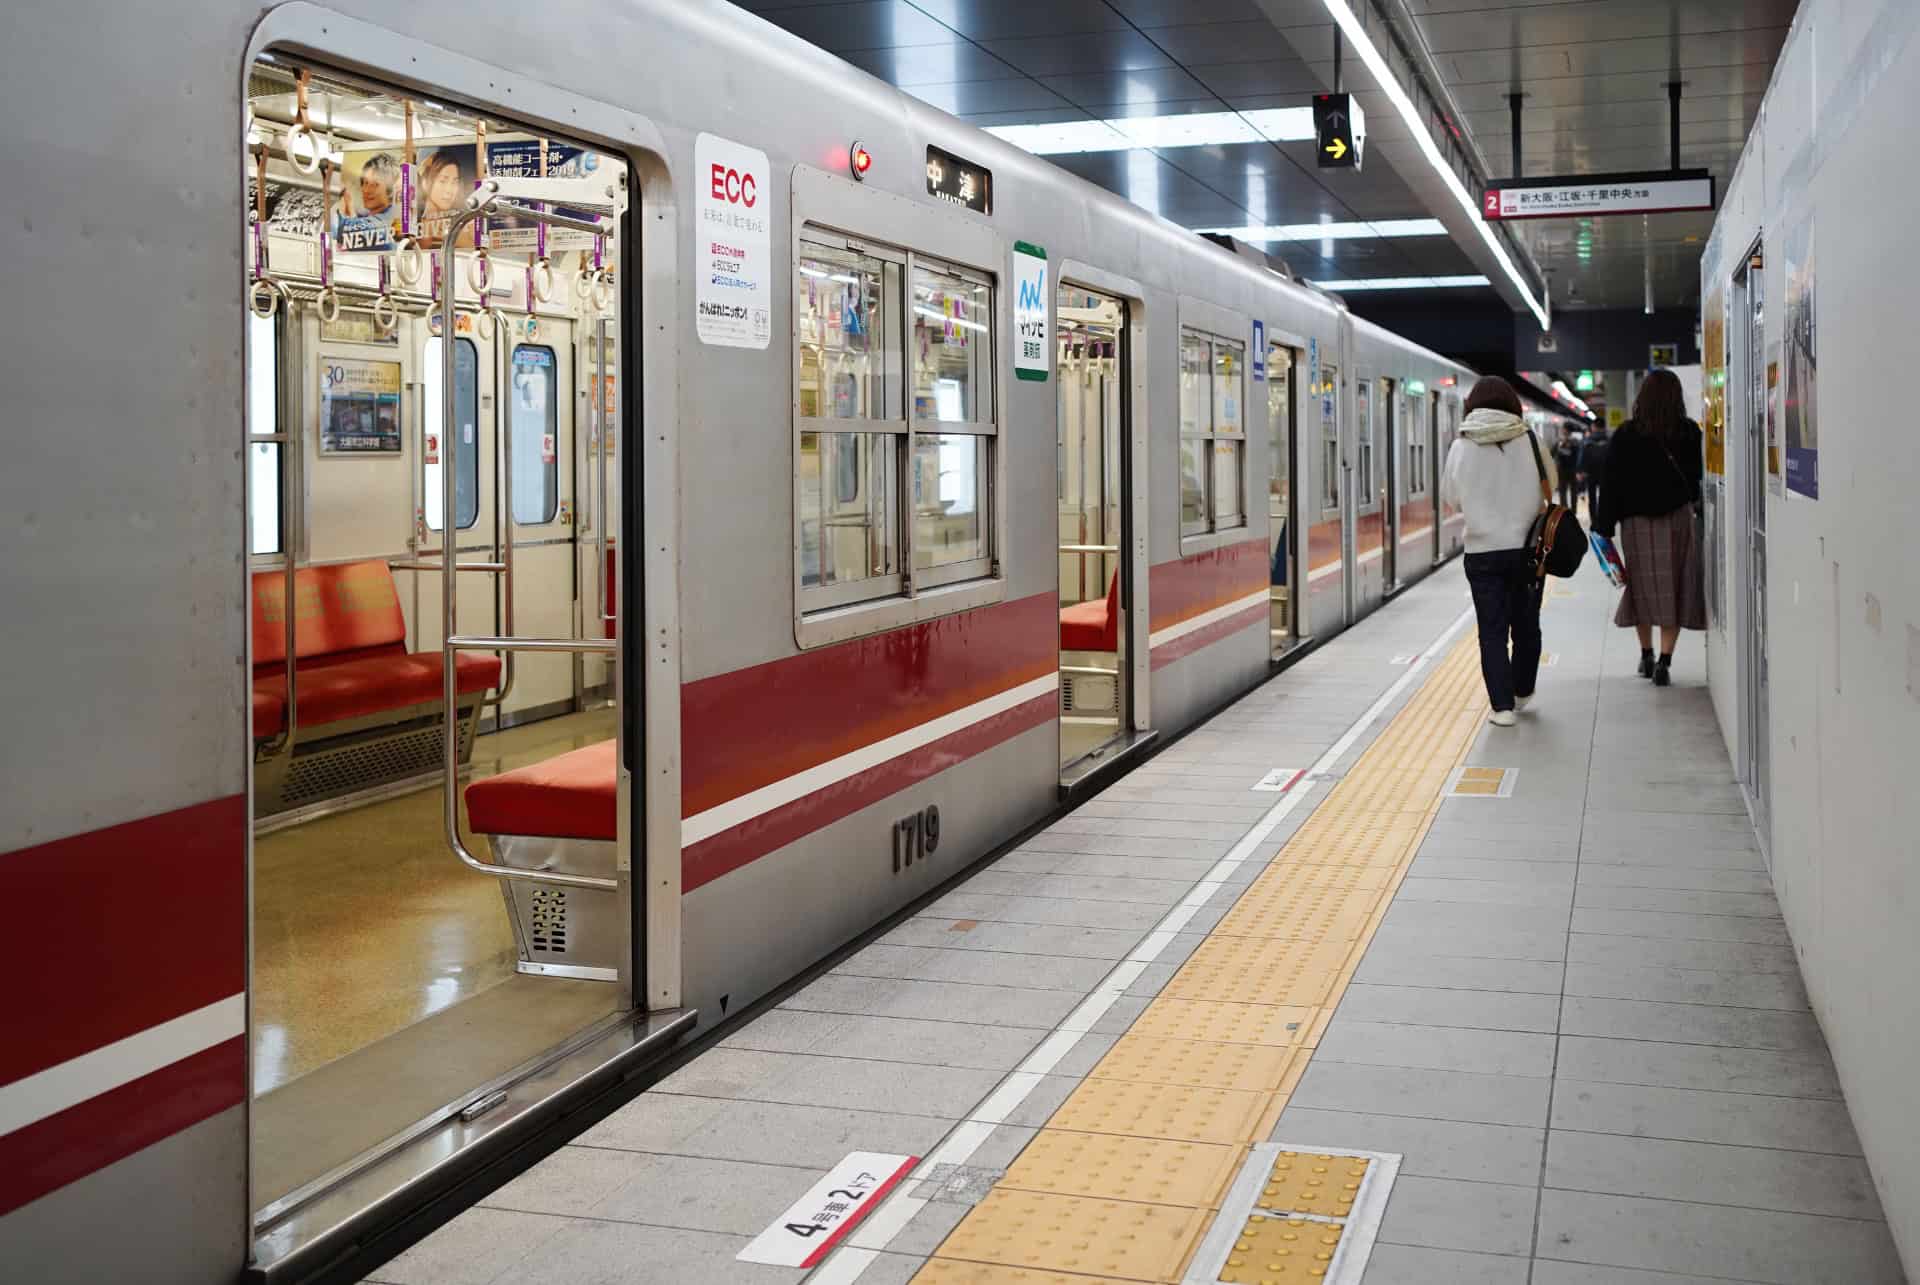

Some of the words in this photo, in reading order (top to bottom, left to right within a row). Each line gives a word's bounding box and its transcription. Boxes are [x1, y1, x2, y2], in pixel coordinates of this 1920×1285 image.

[712, 163, 756, 208] ECC
[928, 160, 975, 201] 中津
[1487, 195, 1498, 210] 2
[892, 804, 940, 875] 1719
